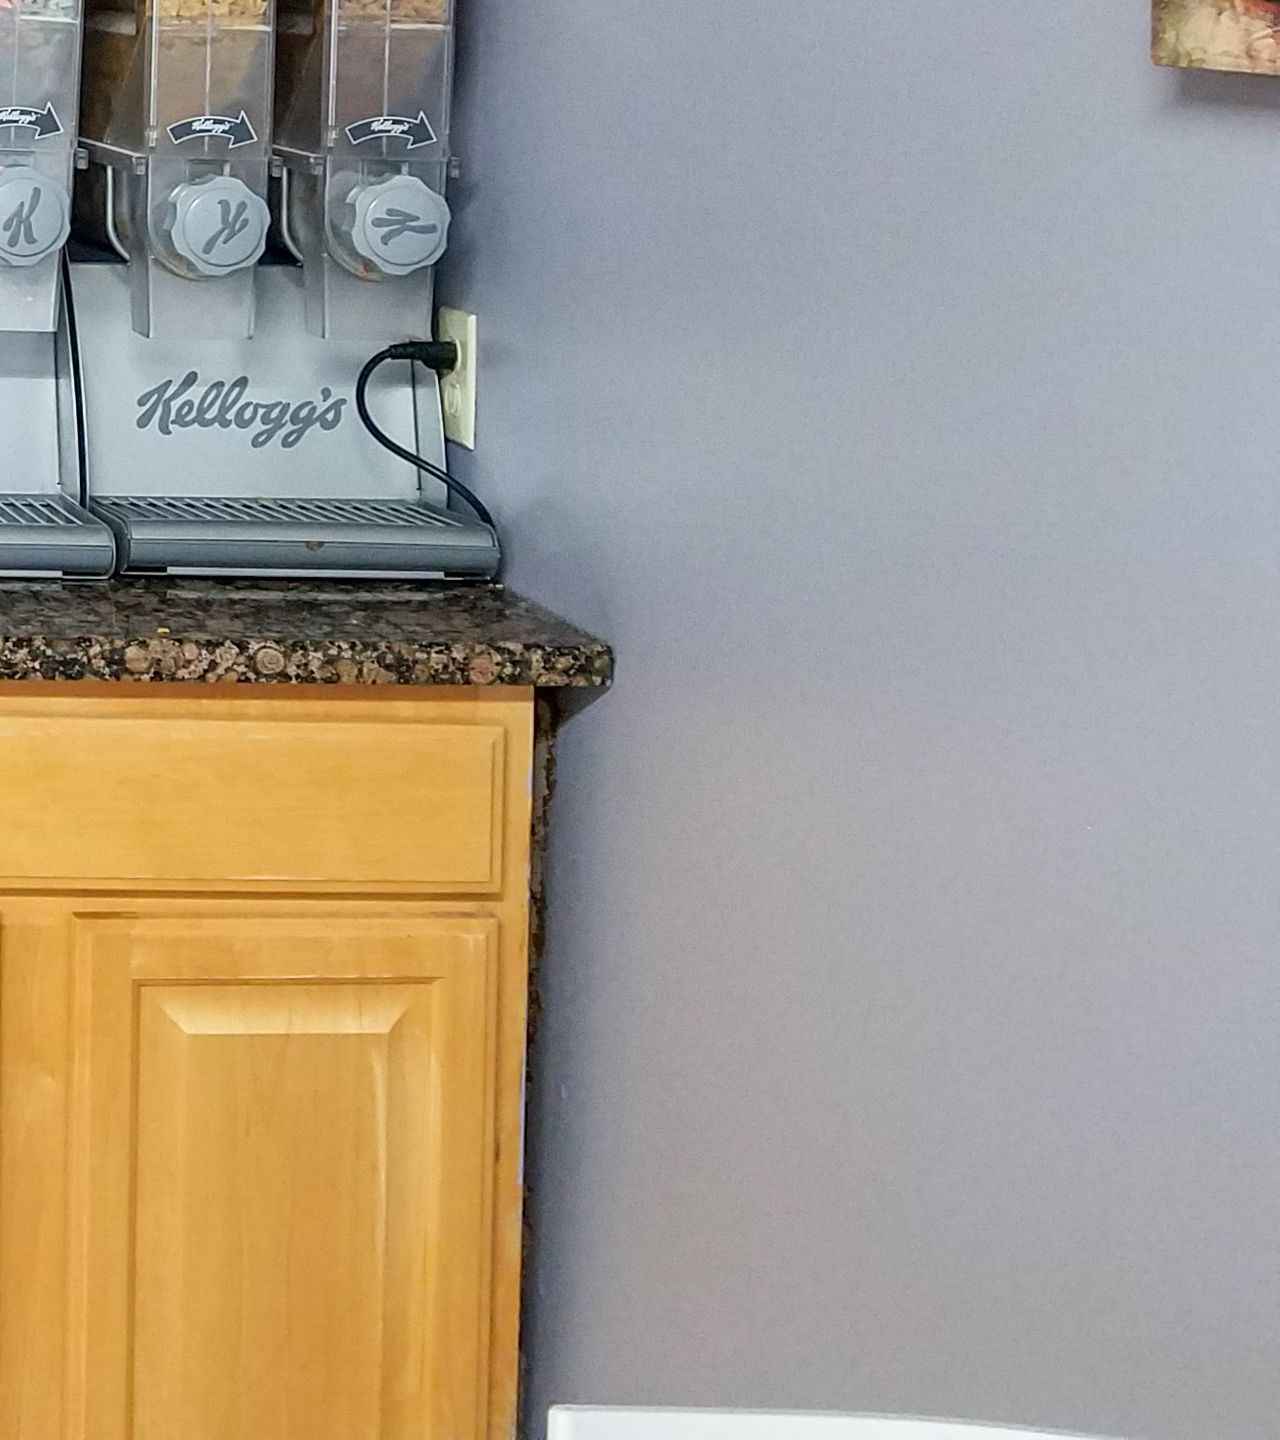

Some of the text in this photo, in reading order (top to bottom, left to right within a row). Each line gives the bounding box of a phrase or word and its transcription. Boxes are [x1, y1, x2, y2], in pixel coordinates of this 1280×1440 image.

[191, 119, 231, 134] Kellogg's
[370, 118, 411, 134] Kellogg's
[136, 370, 347, 449] Kellogg's
